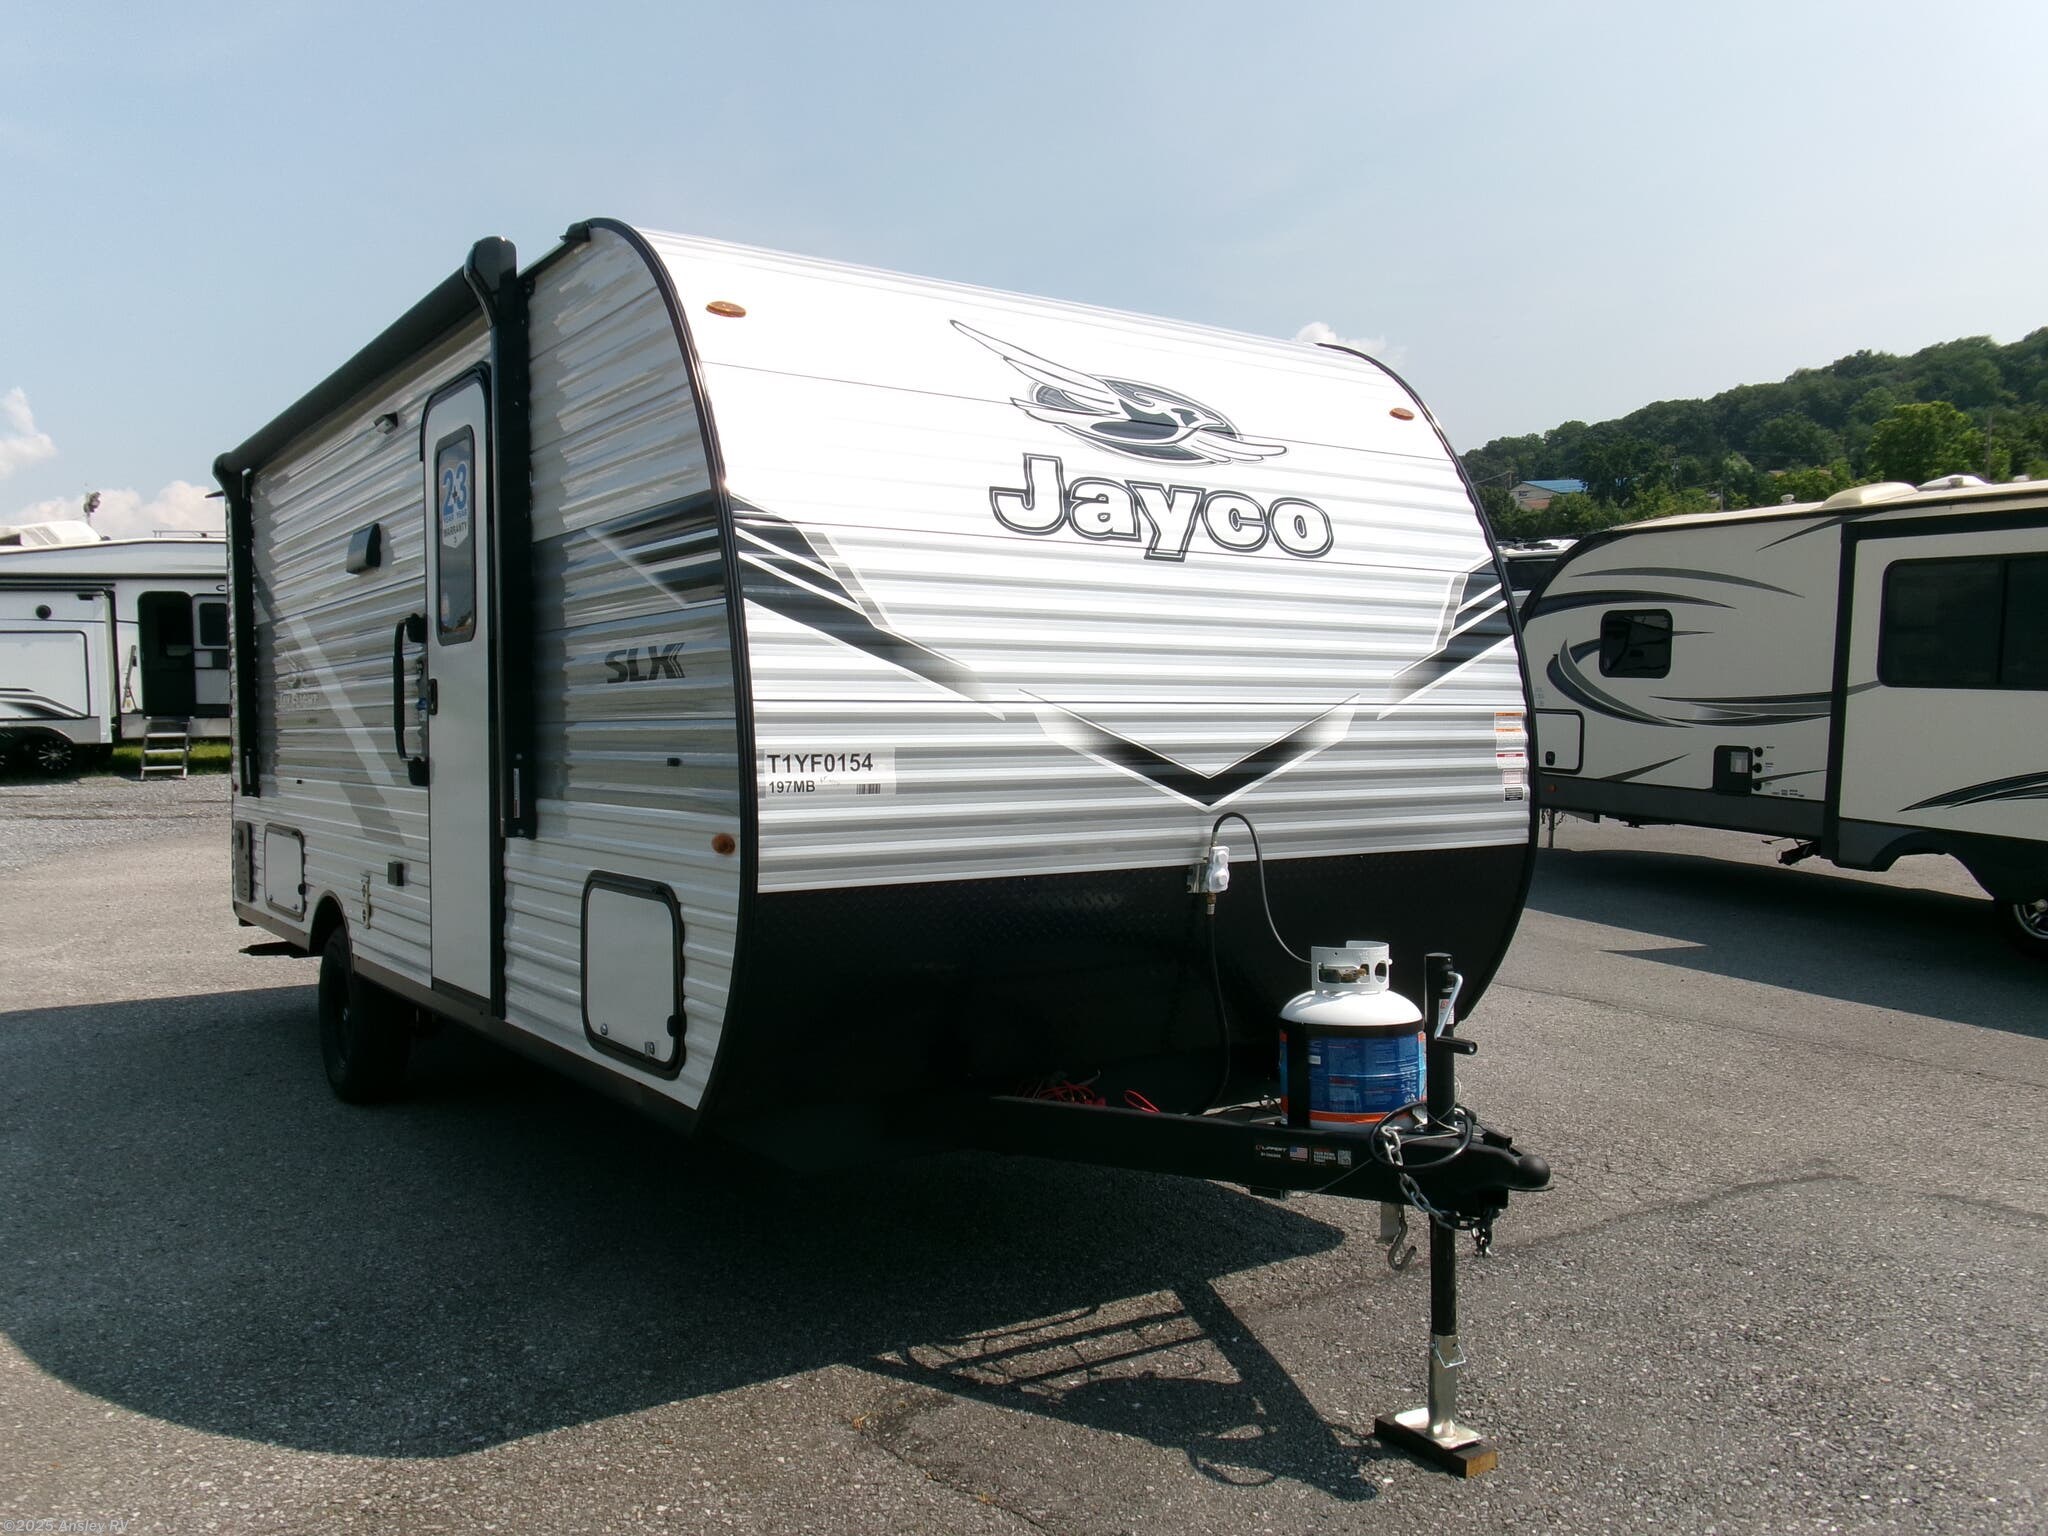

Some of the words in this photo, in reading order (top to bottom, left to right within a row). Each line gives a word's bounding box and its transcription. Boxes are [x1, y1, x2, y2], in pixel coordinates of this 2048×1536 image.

[989, 452, 1335, 563] Jayco
[766, 753, 874, 773] T1YF0154
[768, 781, 816, 793] 197MB
